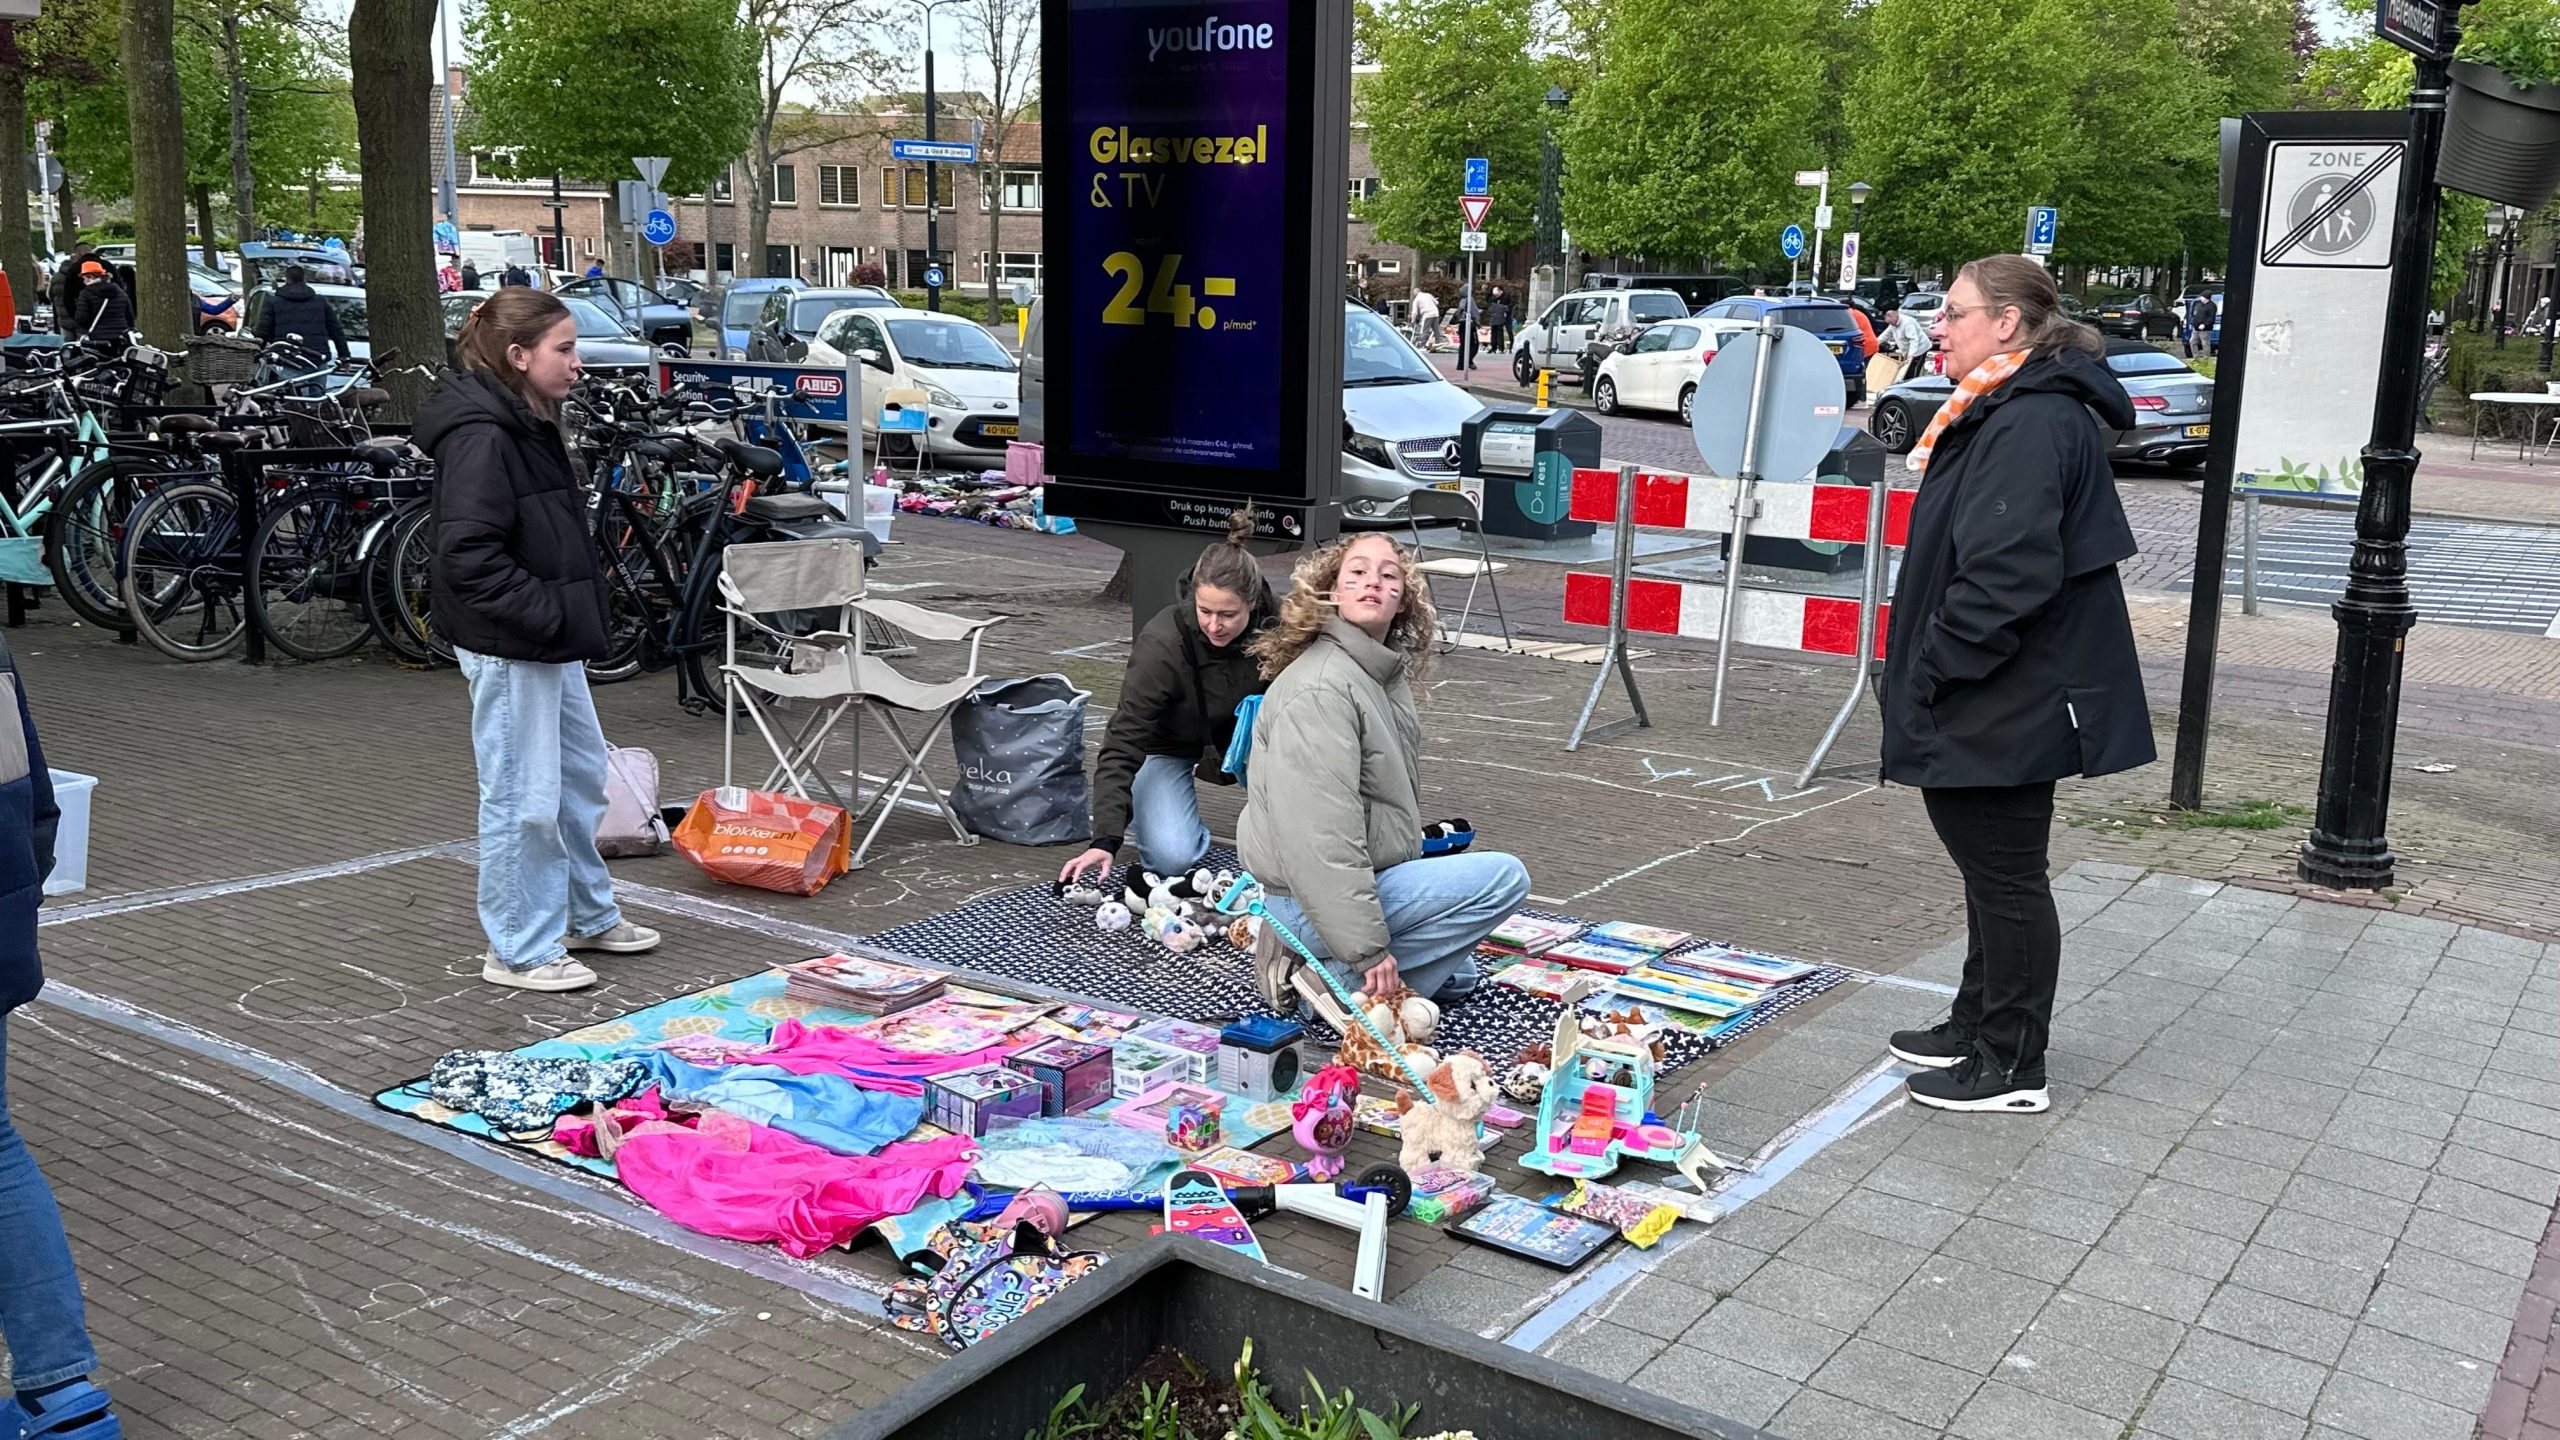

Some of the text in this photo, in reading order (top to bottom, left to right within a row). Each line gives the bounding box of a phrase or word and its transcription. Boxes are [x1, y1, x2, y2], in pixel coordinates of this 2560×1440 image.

[1148, 16, 1273, 62] youfone
[1090, 125, 1267, 164] Glasvezel
[2308, 152, 2367, 167] ZONE
[1090, 172, 1166, 208] & TV
[801, 379, 837, 392] ABUS
[1538, 461, 1546, 485] rest
[1170, 500, 1192, 511] Druk
[1194, 505, 1206, 514] op
[1208, 504, 1231, 517] knop
[1183, 515, 1206, 527] Push
[1256, 522, 1275, 533] info
[713, 823, 797, 841] blokker.nl
